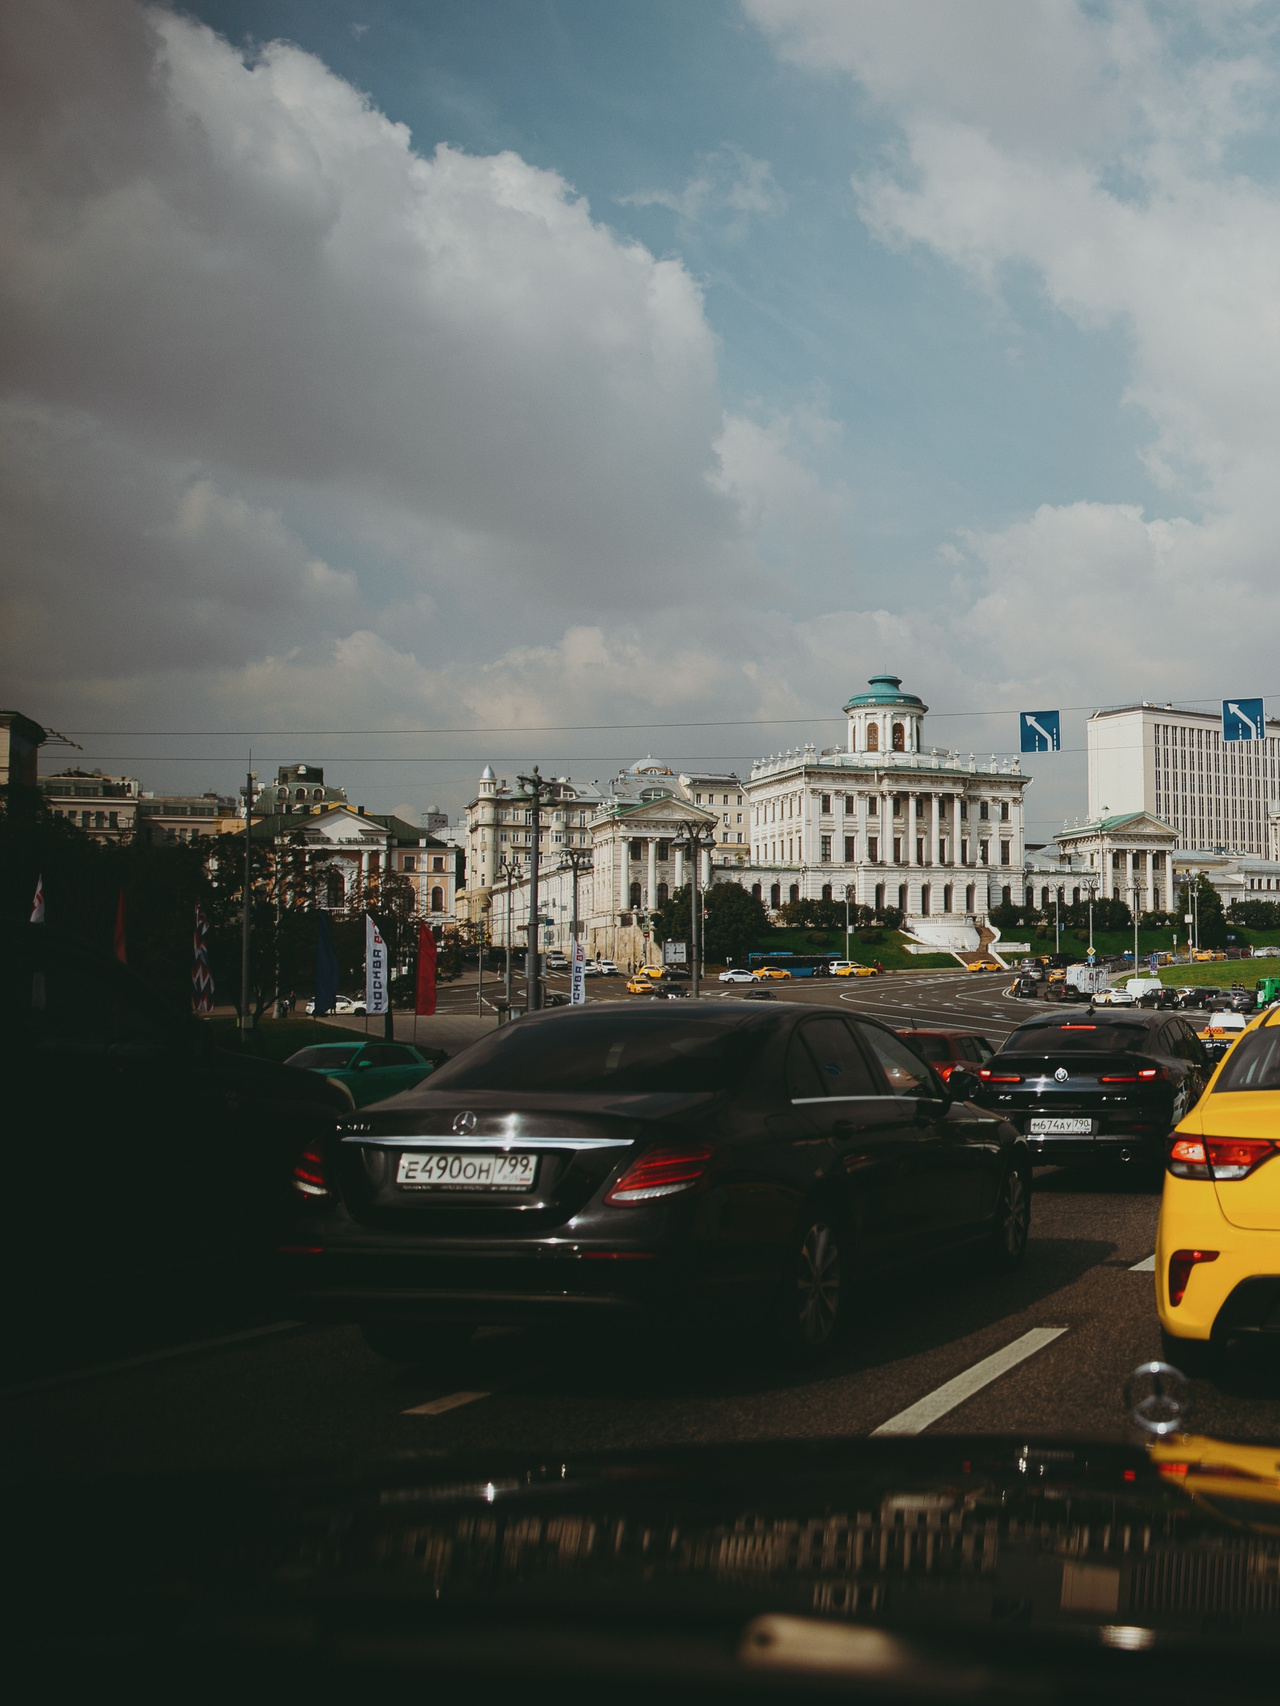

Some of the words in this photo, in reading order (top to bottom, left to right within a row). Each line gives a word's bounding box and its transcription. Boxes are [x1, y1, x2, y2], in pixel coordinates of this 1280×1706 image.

[373, 949, 383, 1011] МОСКВА
[405, 1154, 492, 1180] Е490ОН
[496, 1155, 530, 1174] 799
